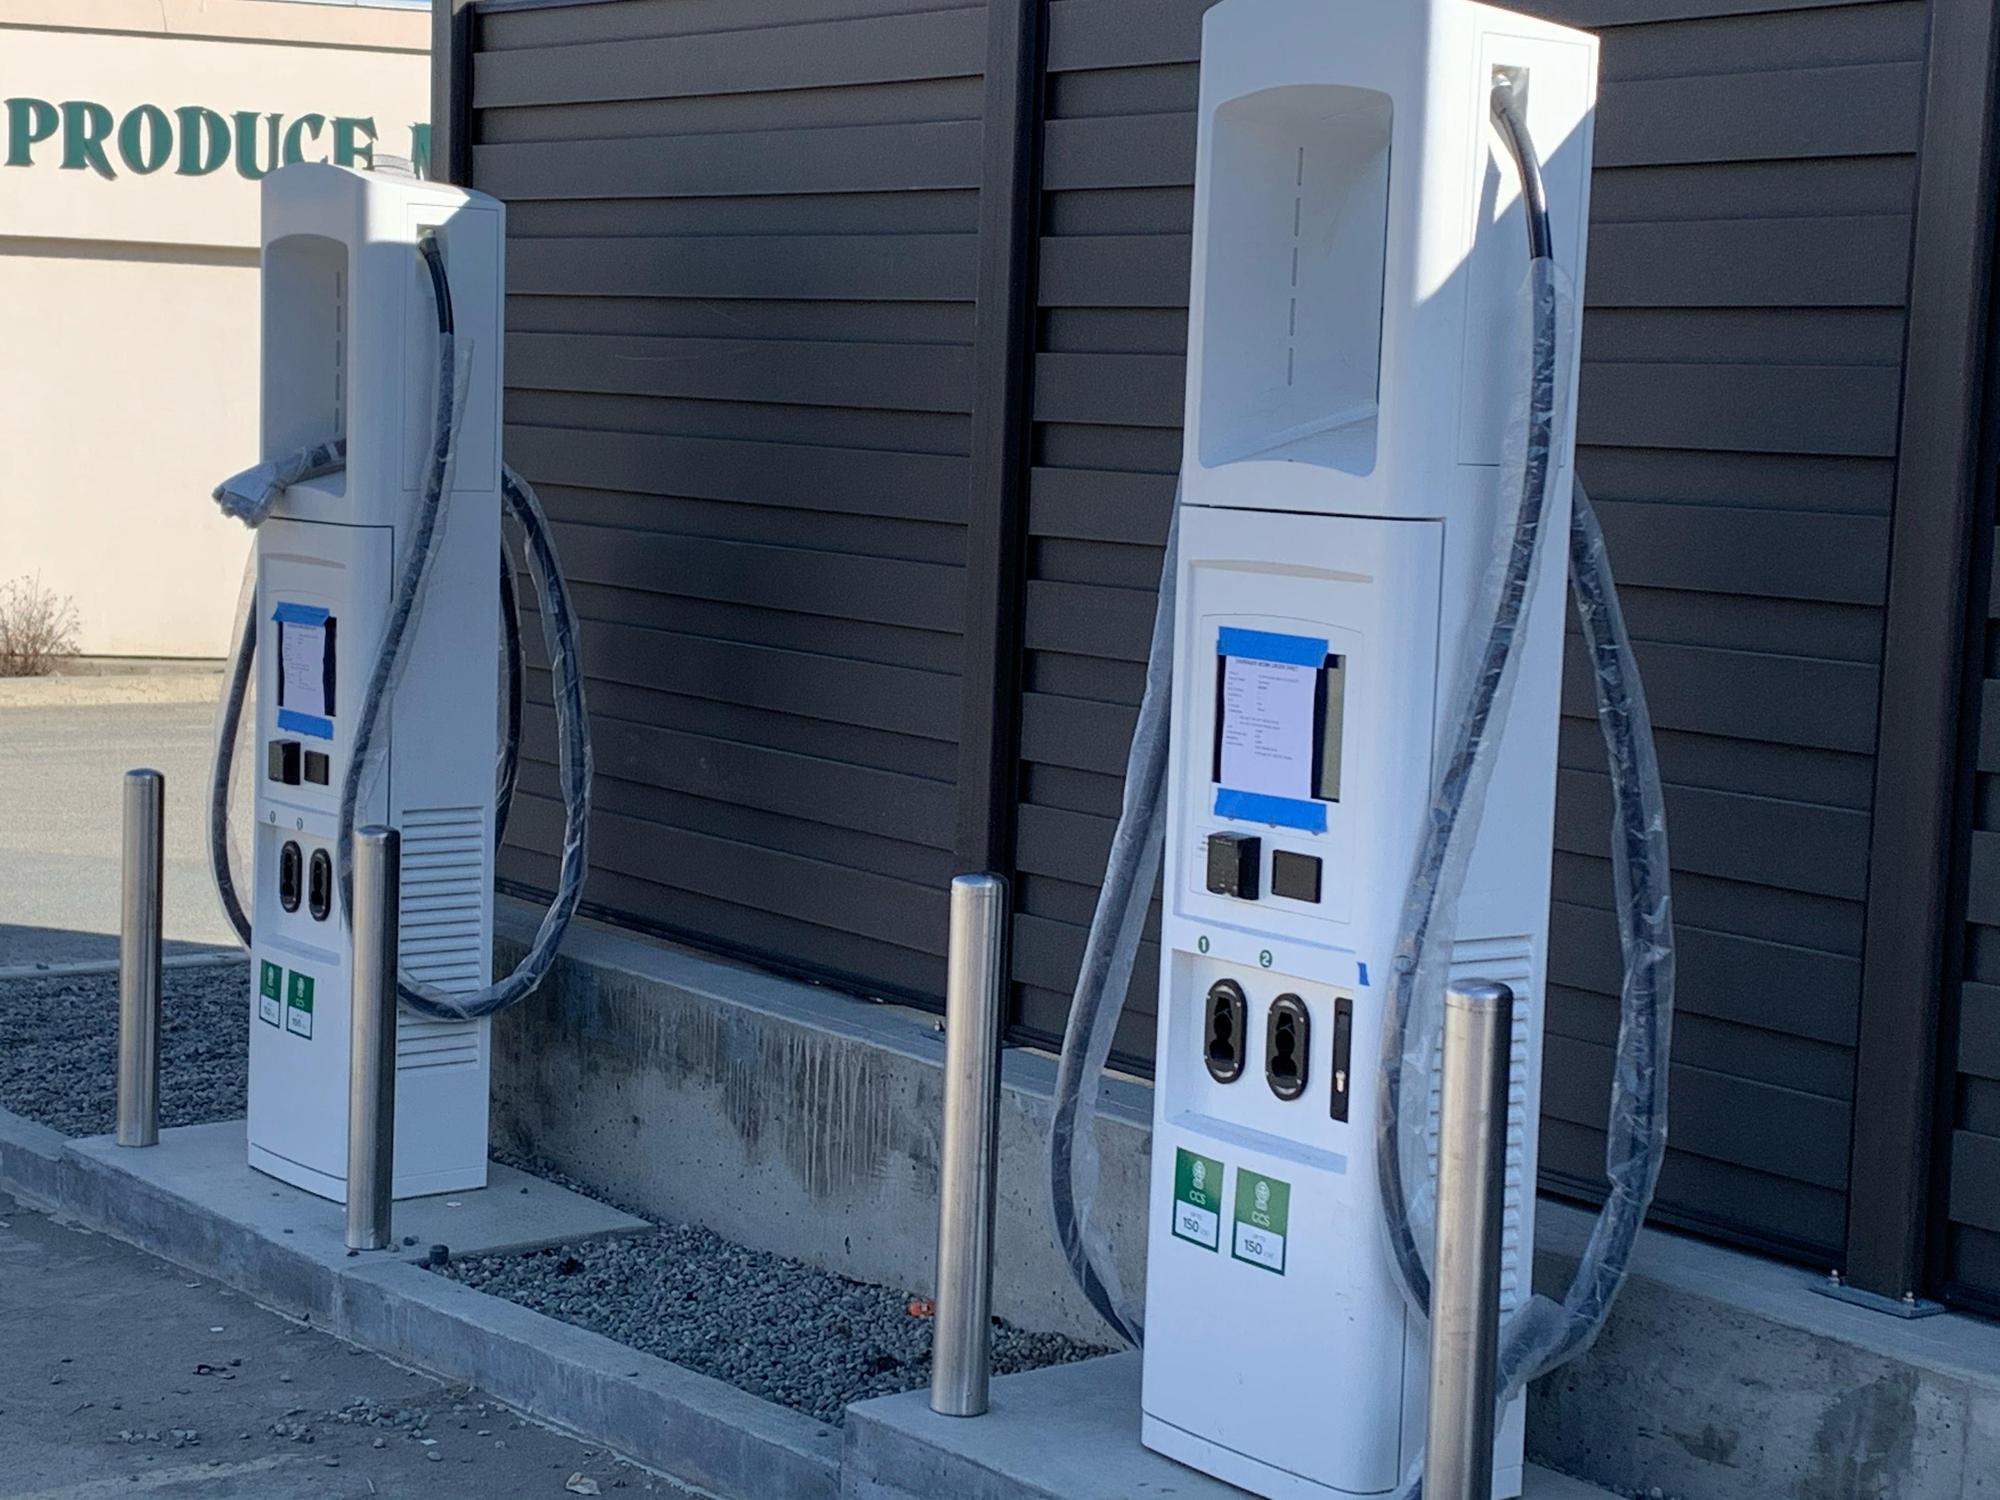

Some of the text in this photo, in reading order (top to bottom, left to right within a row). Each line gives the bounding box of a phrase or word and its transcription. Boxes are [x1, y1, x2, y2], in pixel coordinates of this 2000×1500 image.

[4, 97, 379, 181] PRODUCE
[1183, 1217, 1200, 1233] 150
[1244, 1239, 1263, 1255] 150
